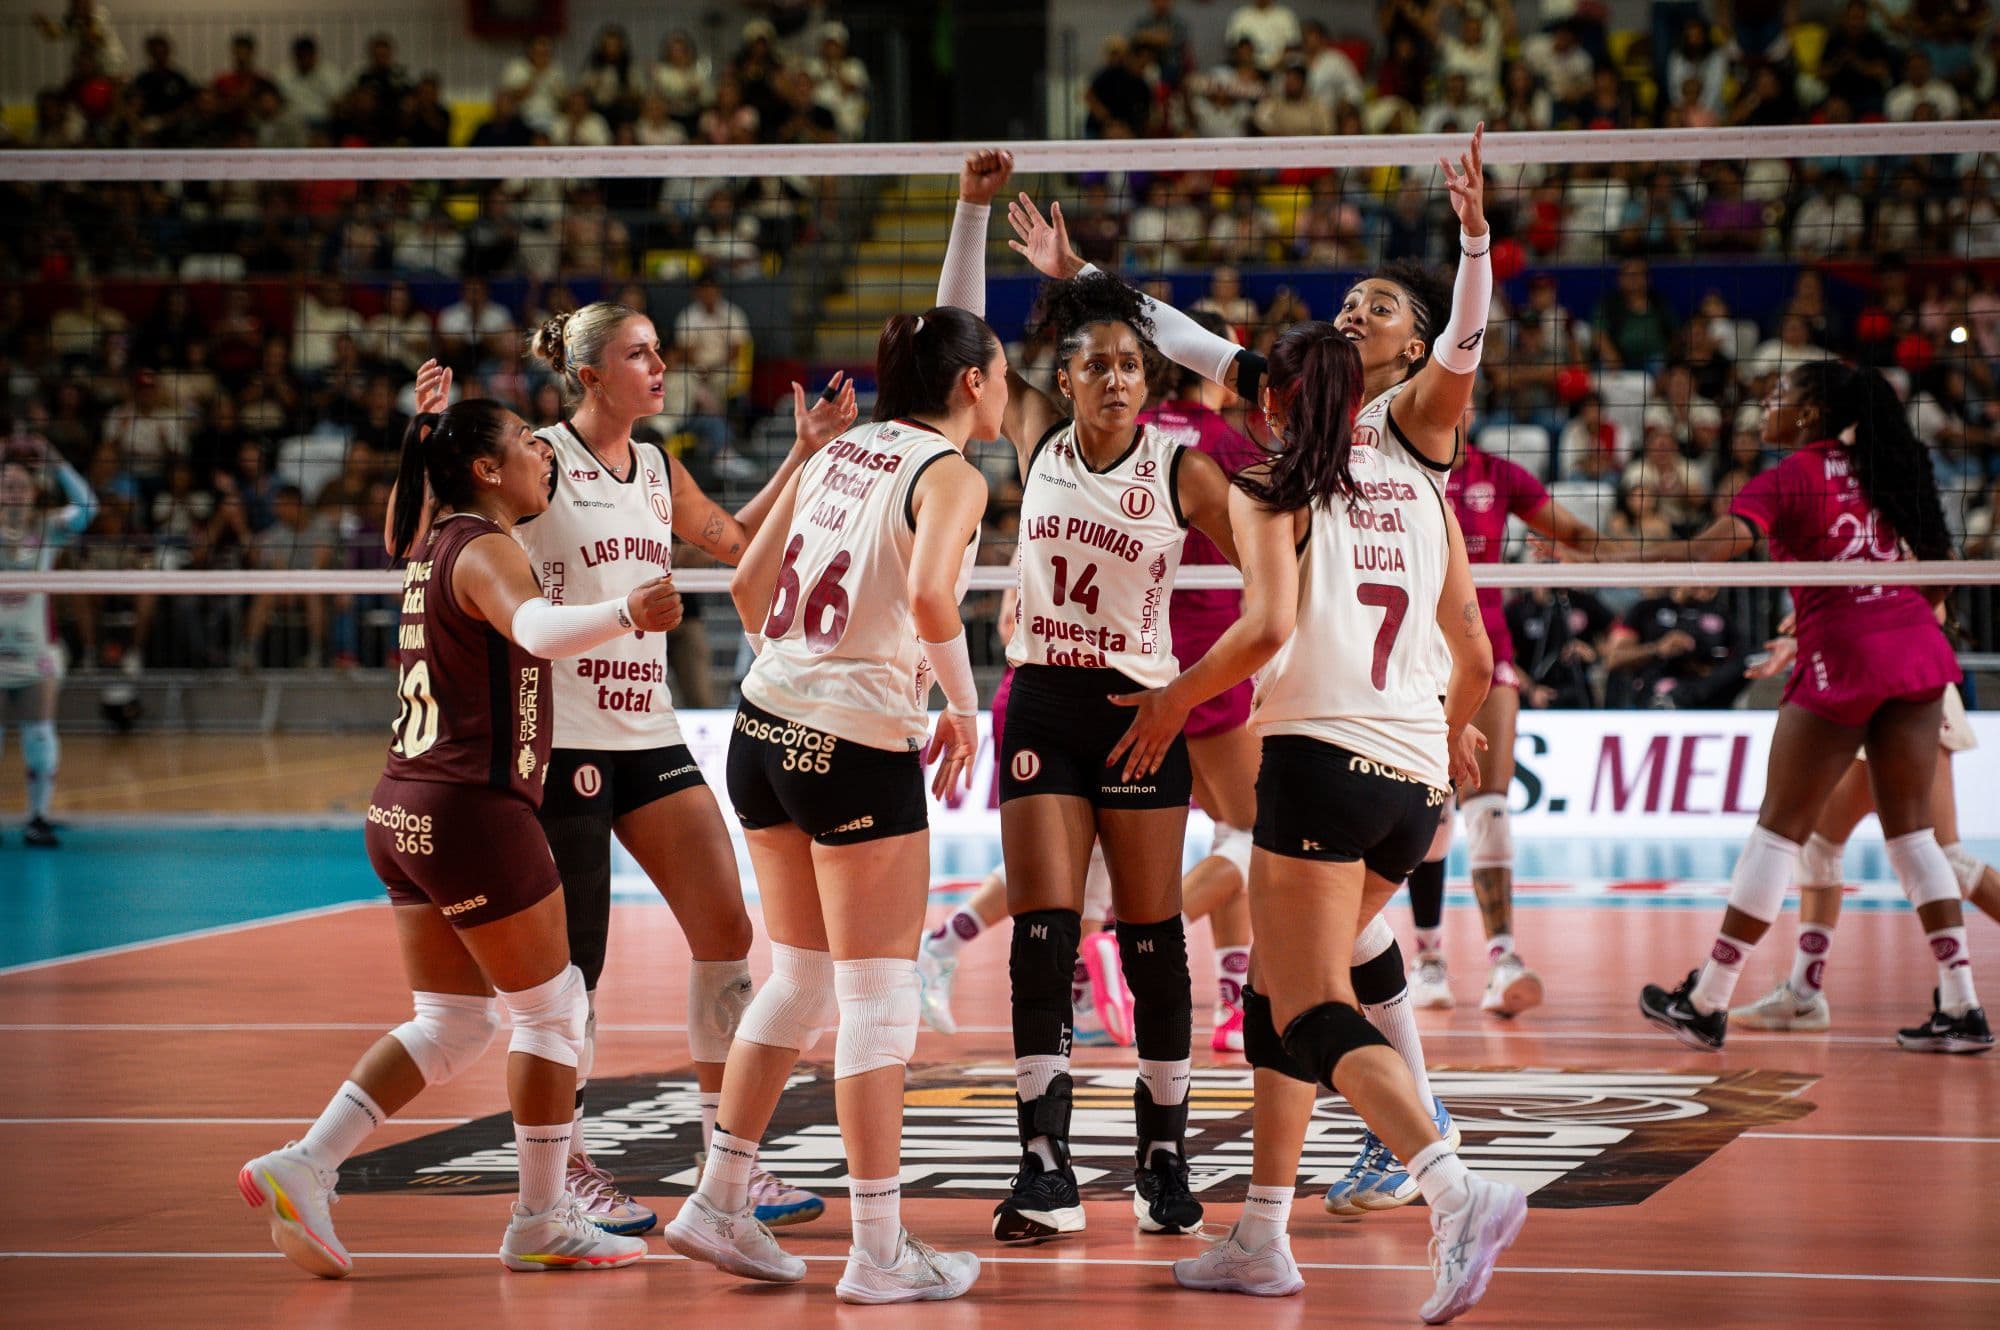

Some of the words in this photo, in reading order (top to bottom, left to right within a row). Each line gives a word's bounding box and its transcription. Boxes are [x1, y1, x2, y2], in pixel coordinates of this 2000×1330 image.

[1038, 472, 1078, 491] marathon
[572, 500, 616, 510] marathon
[810, 502, 848, 532] AIXA
[1128, 492, 1148, 516] U
[1348, 506, 1406, 534] total
[580, 537, 620, 569] LAS
[1027, 515, 1060, 542] LAS
[1066, 517, 1144, 563] PUMAS
[1353, 543, 1406, 572] LUCIA
[764, 533, 851, 655] 66
[1050, 555, 1100, 616] 14
[1031, 615, 1127, 653] apuesta
[1140, 587, 1156, 655] WORLD
[1151, 586, 1163, 655] COLECTIVO
[1356, 582, 1410, 692] 7
[577, 657, 663, 685] apuesta
[1046, 644, 1107, 668] total
[519, 667, 529, 742] COLECTIVO
[527, 666, 539, 741] WORLD
[597, 685, 653, 713] total
[735, 711, 838, 753] mascotas
[782, 748, 832, 775] 365
[579, 769, 597, 794] U
[1101, 784, 1157, 794] marathon
[367, 803, 433, 833] ascotas
[395, 832, 434, 855] 365
